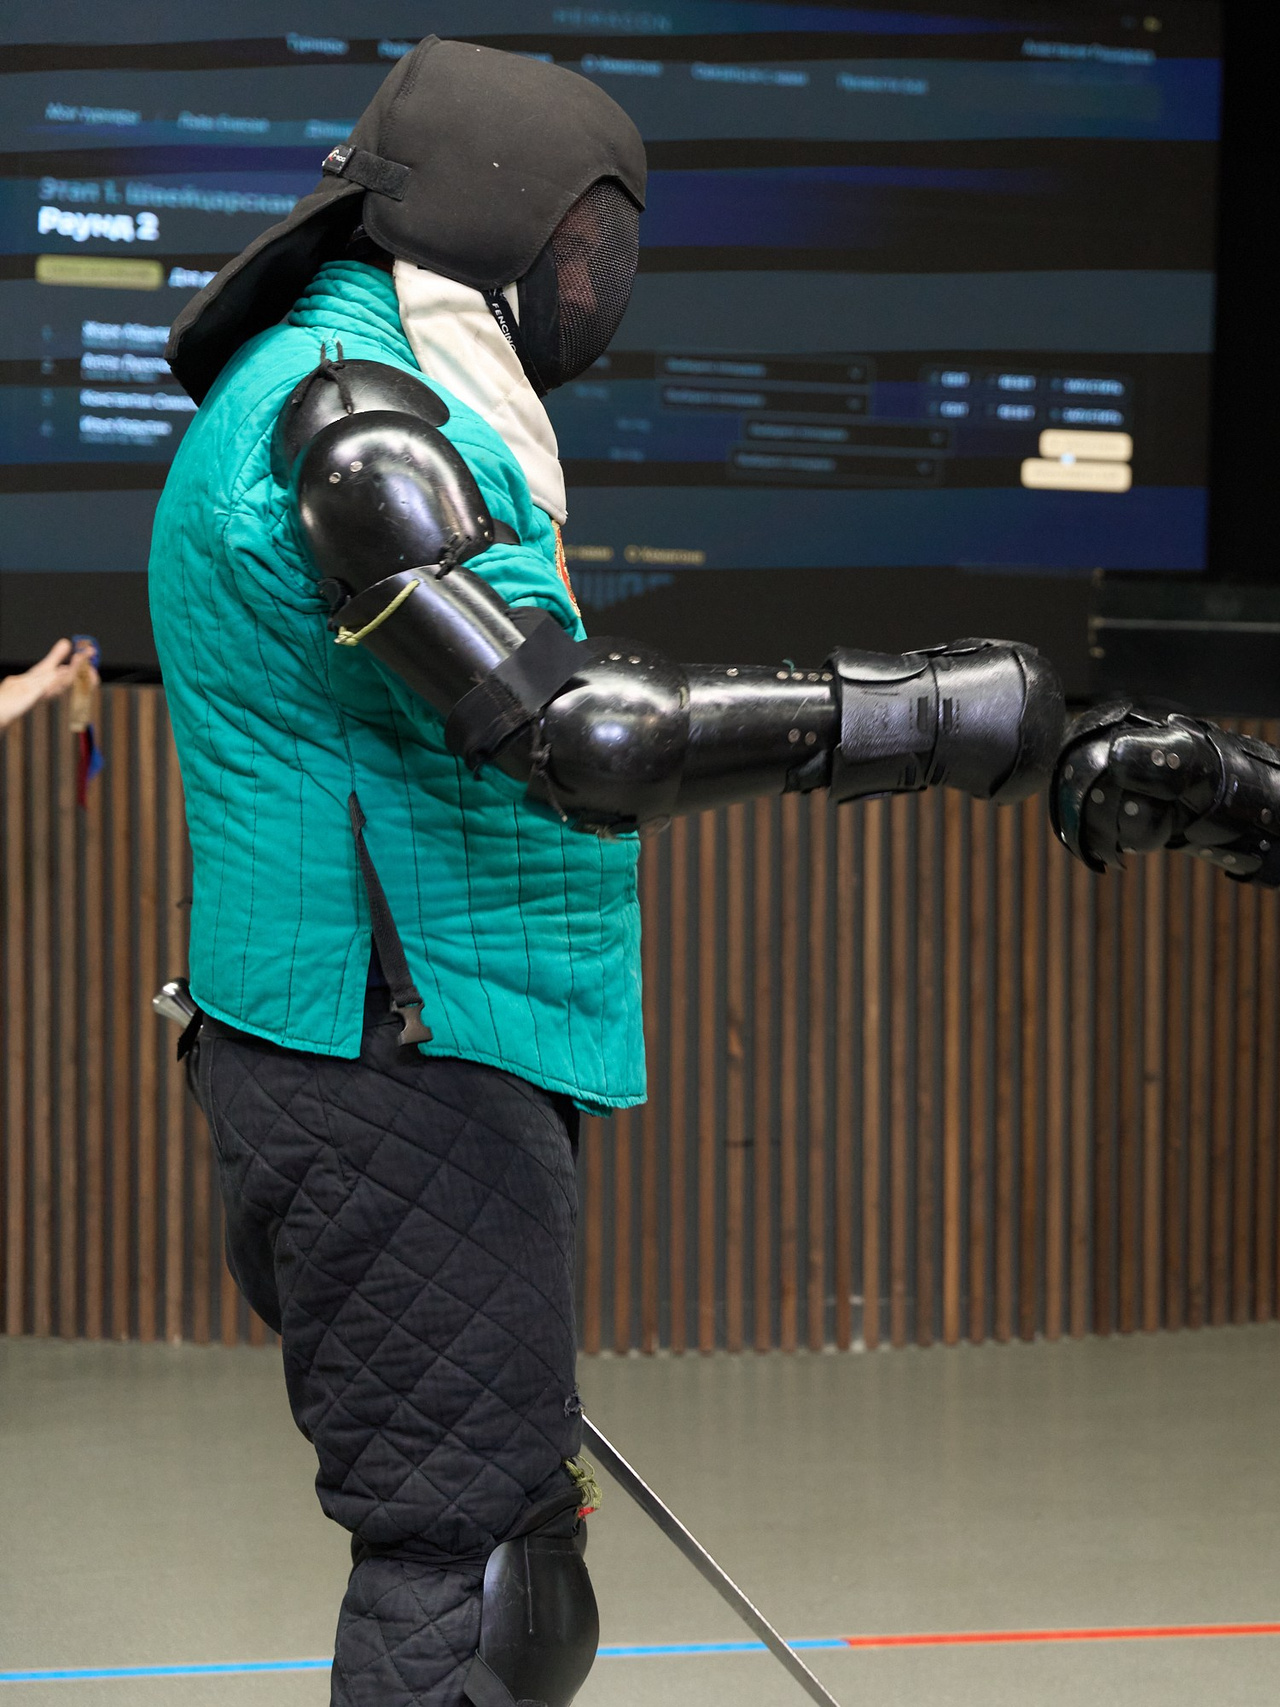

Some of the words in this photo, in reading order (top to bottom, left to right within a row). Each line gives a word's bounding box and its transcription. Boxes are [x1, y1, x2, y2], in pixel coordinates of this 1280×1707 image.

[38, 178, 101, 202] Этап
[37, 205, 137, 242] Раунд
[136, 212, 160, 242] 2
